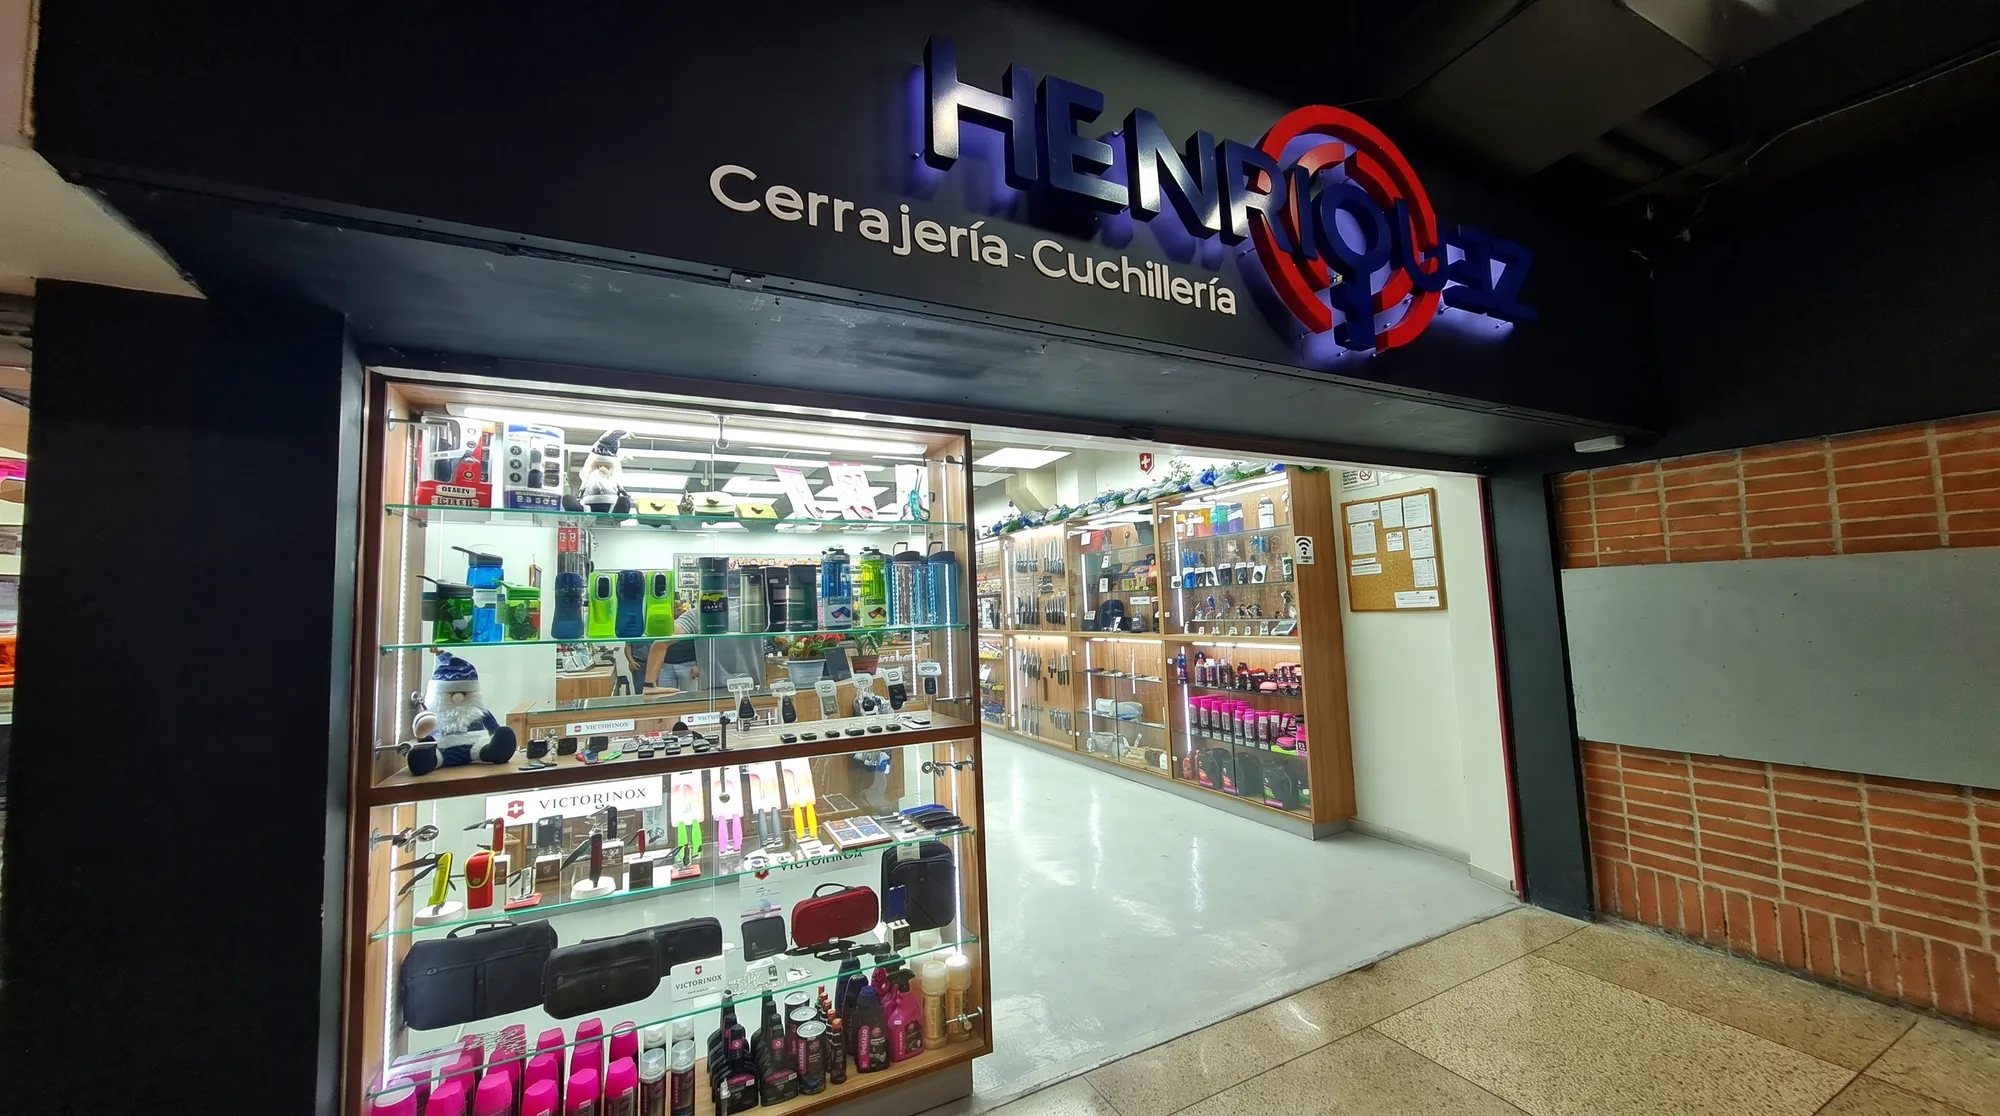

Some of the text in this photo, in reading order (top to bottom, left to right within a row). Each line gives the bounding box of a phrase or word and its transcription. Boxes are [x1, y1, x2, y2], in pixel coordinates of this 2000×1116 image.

[922, 34, 1540, 352] HENRIQUEZ
[539, 787, 646, 810] VICTORINOX
[675, 974, 722, 990] VICTORINOX
